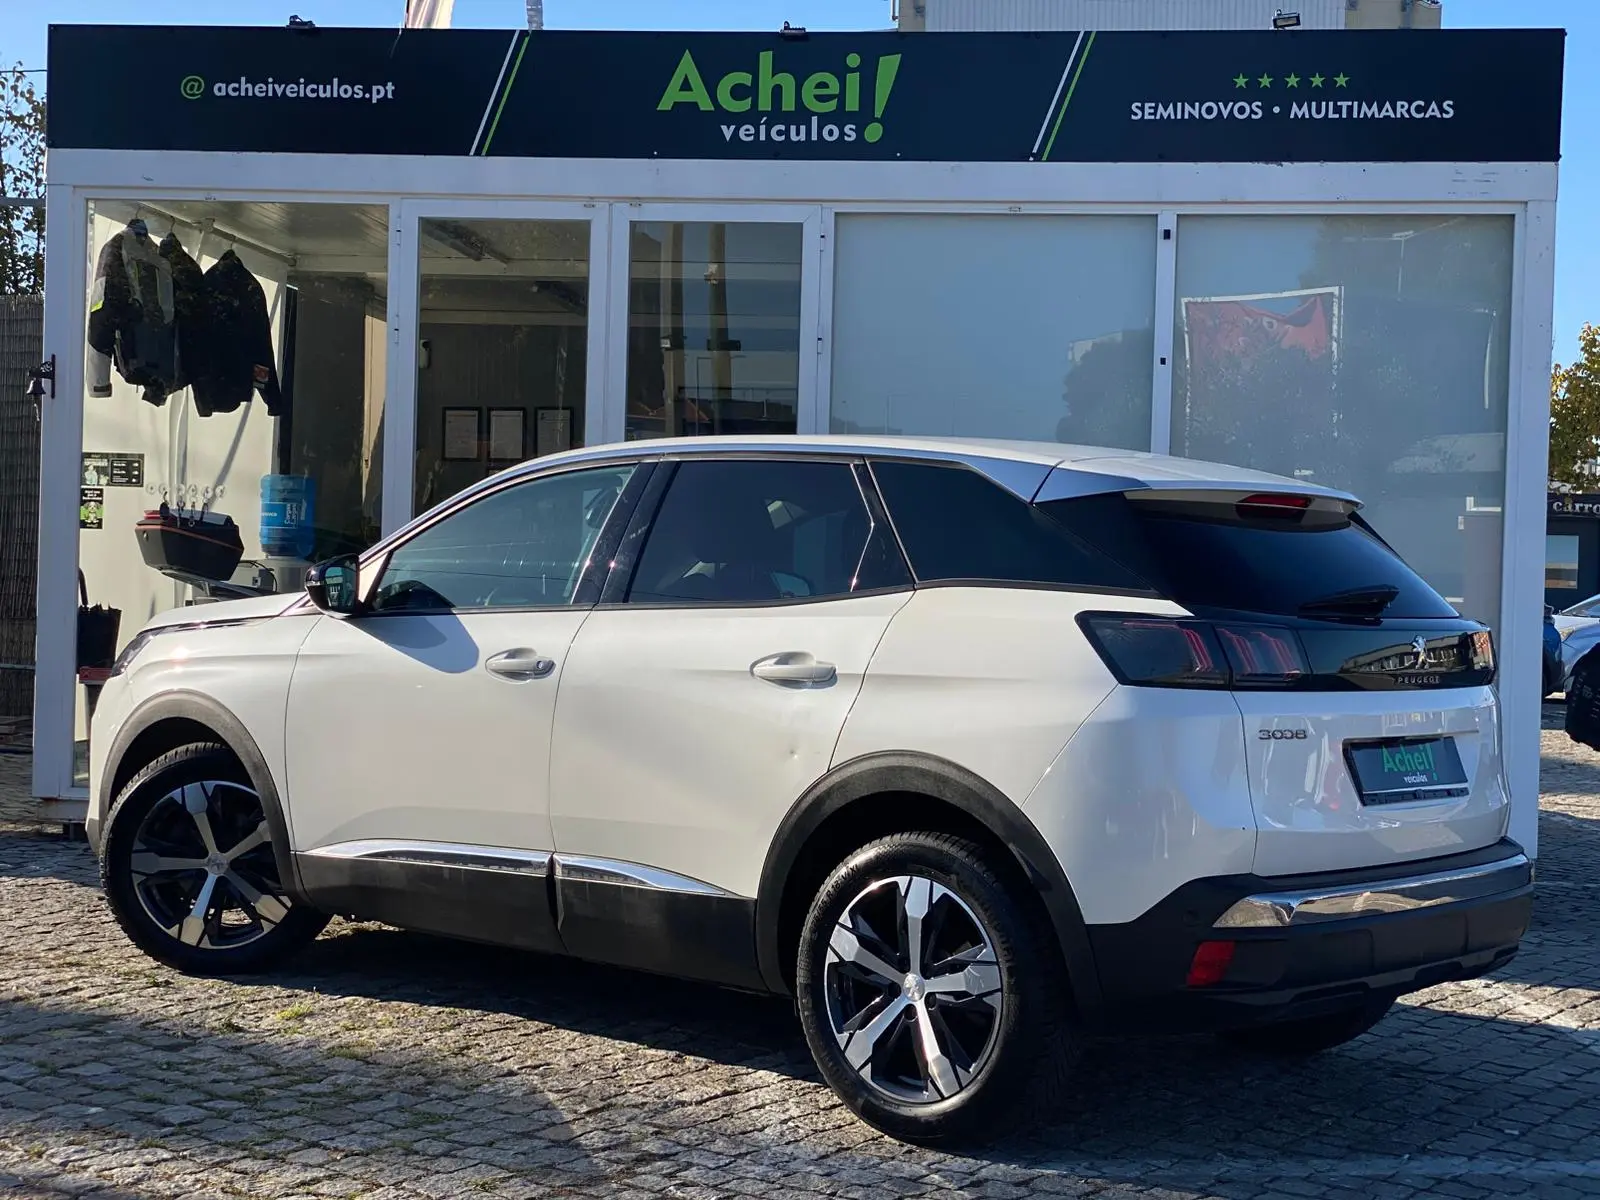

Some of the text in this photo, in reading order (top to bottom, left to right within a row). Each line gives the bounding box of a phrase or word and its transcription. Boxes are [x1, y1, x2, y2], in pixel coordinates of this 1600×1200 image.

[213, 76, 396, 103] acheiveiculos.pt
[657, 49, 902, 143] Achei!
[1131, 100, 1455, 120] SEMINOVOS MULTIMARCAS
[721, 116, 857, 142] veículos
[1397, 675, 1441, 685] PEUGEOT
[1258, 729, 1308, 740] 3008
[1382, 743, 1439, 782] Achei!
